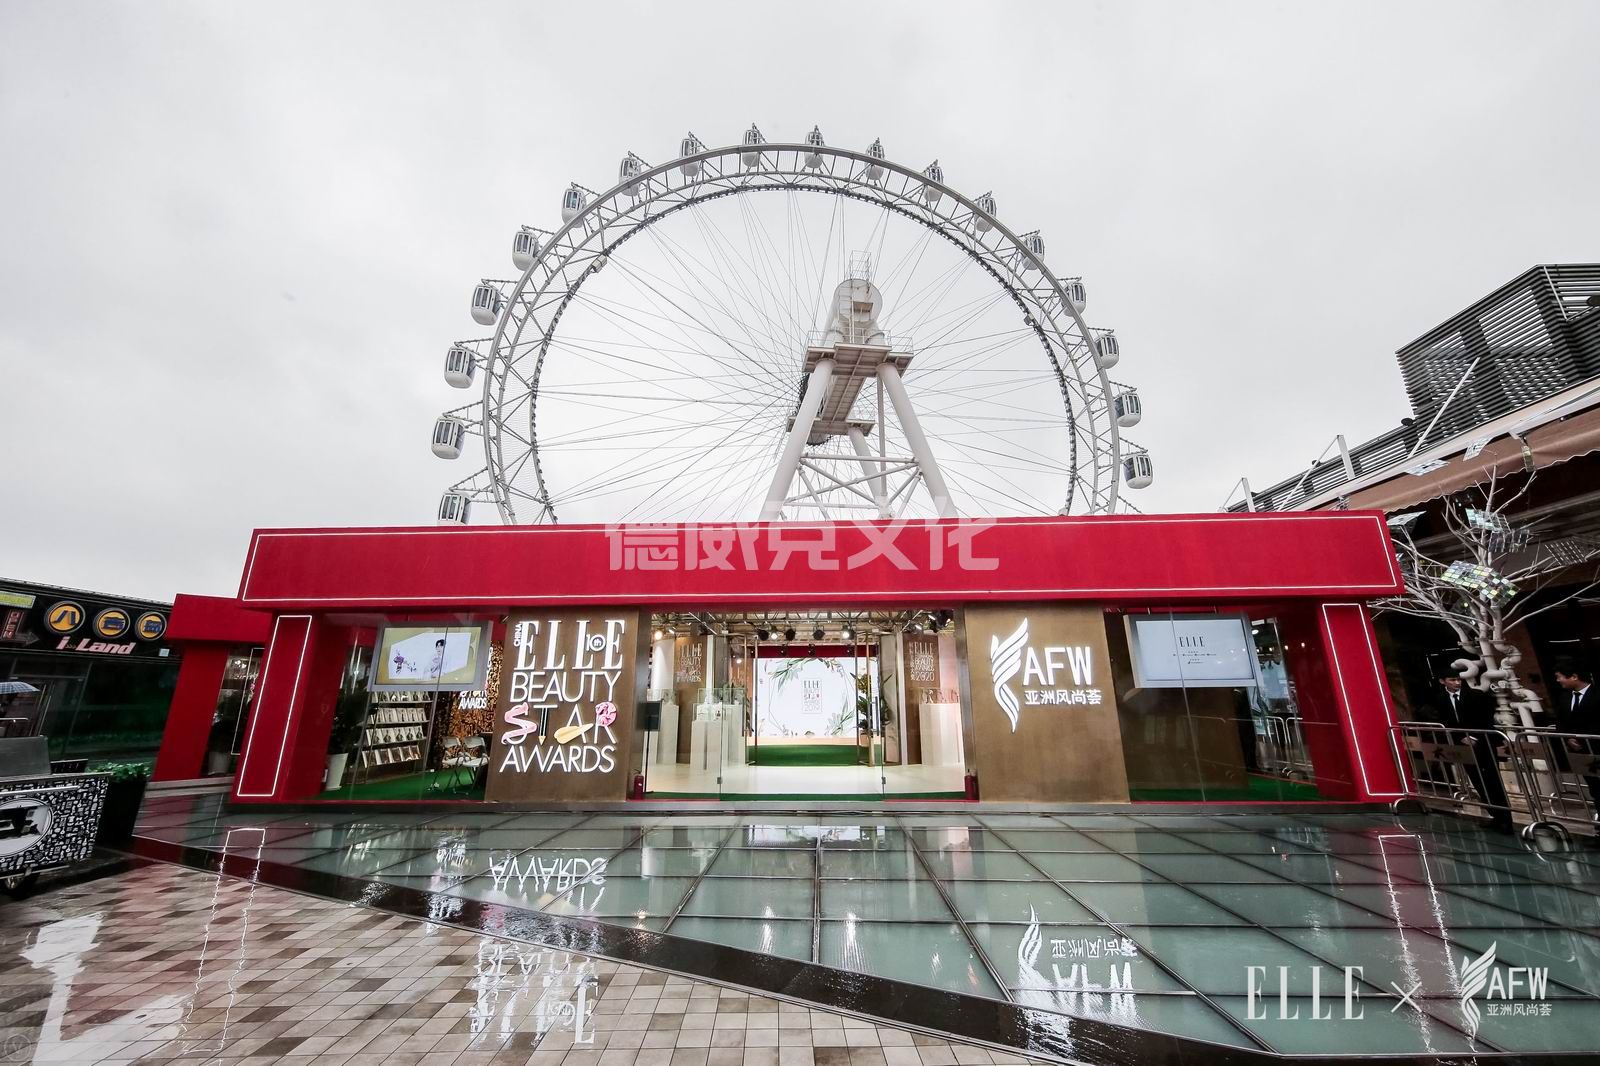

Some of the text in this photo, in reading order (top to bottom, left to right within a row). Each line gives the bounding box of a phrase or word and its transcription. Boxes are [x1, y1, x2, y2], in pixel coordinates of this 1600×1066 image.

[513, 623, 522, 647] CHINA
[514, 619, 625, 670] ELLE
[1177, 636, 1206, 648] ELLE
[1023, 646, 1092, 686] AFW
[510, 671, 622, 703] BEAUTY
[1024, 689, 1102, 705] 亚洲风尚荟
[458, 697, 487, 710] AWARDS
[501, 702, 618, 746] STAR
[499, 744, 617, 774] AWARDS
